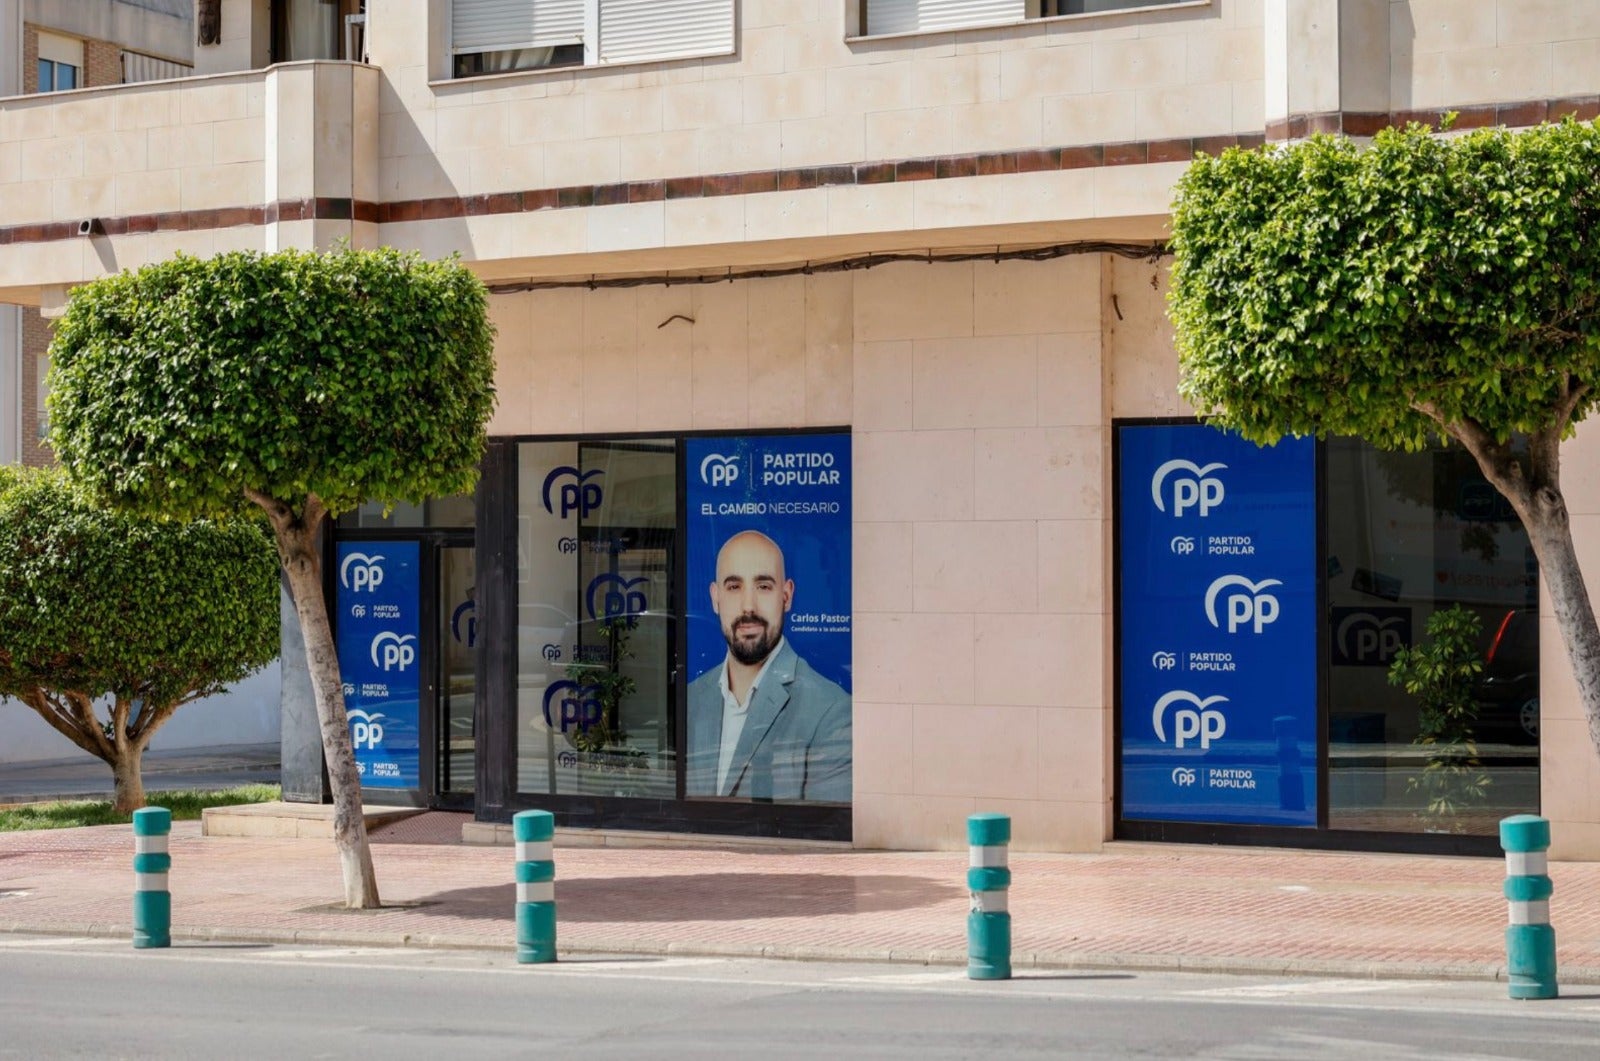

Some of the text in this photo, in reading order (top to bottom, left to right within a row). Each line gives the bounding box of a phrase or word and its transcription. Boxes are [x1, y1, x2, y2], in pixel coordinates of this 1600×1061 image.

[764, 453, 834, 468] PARTIDO
[764, 470, 840, 486] POPULAR
[701, 502, 840, 515] EL CAMBIO NECESARIO
[1208, 536, 1252, 545] PARTIDO
[1208, 546, 1255, 555] POPULAR
[791, 613, 850, 623] Carlos Pastor
[1189, 652, 1232, 662] PARTIDO
[1189, 662, 1236, 671] POPULAR
[1210, 769, 1252, 779] PARTIDO
[1210, 779, 1256, 789] POPULAR
